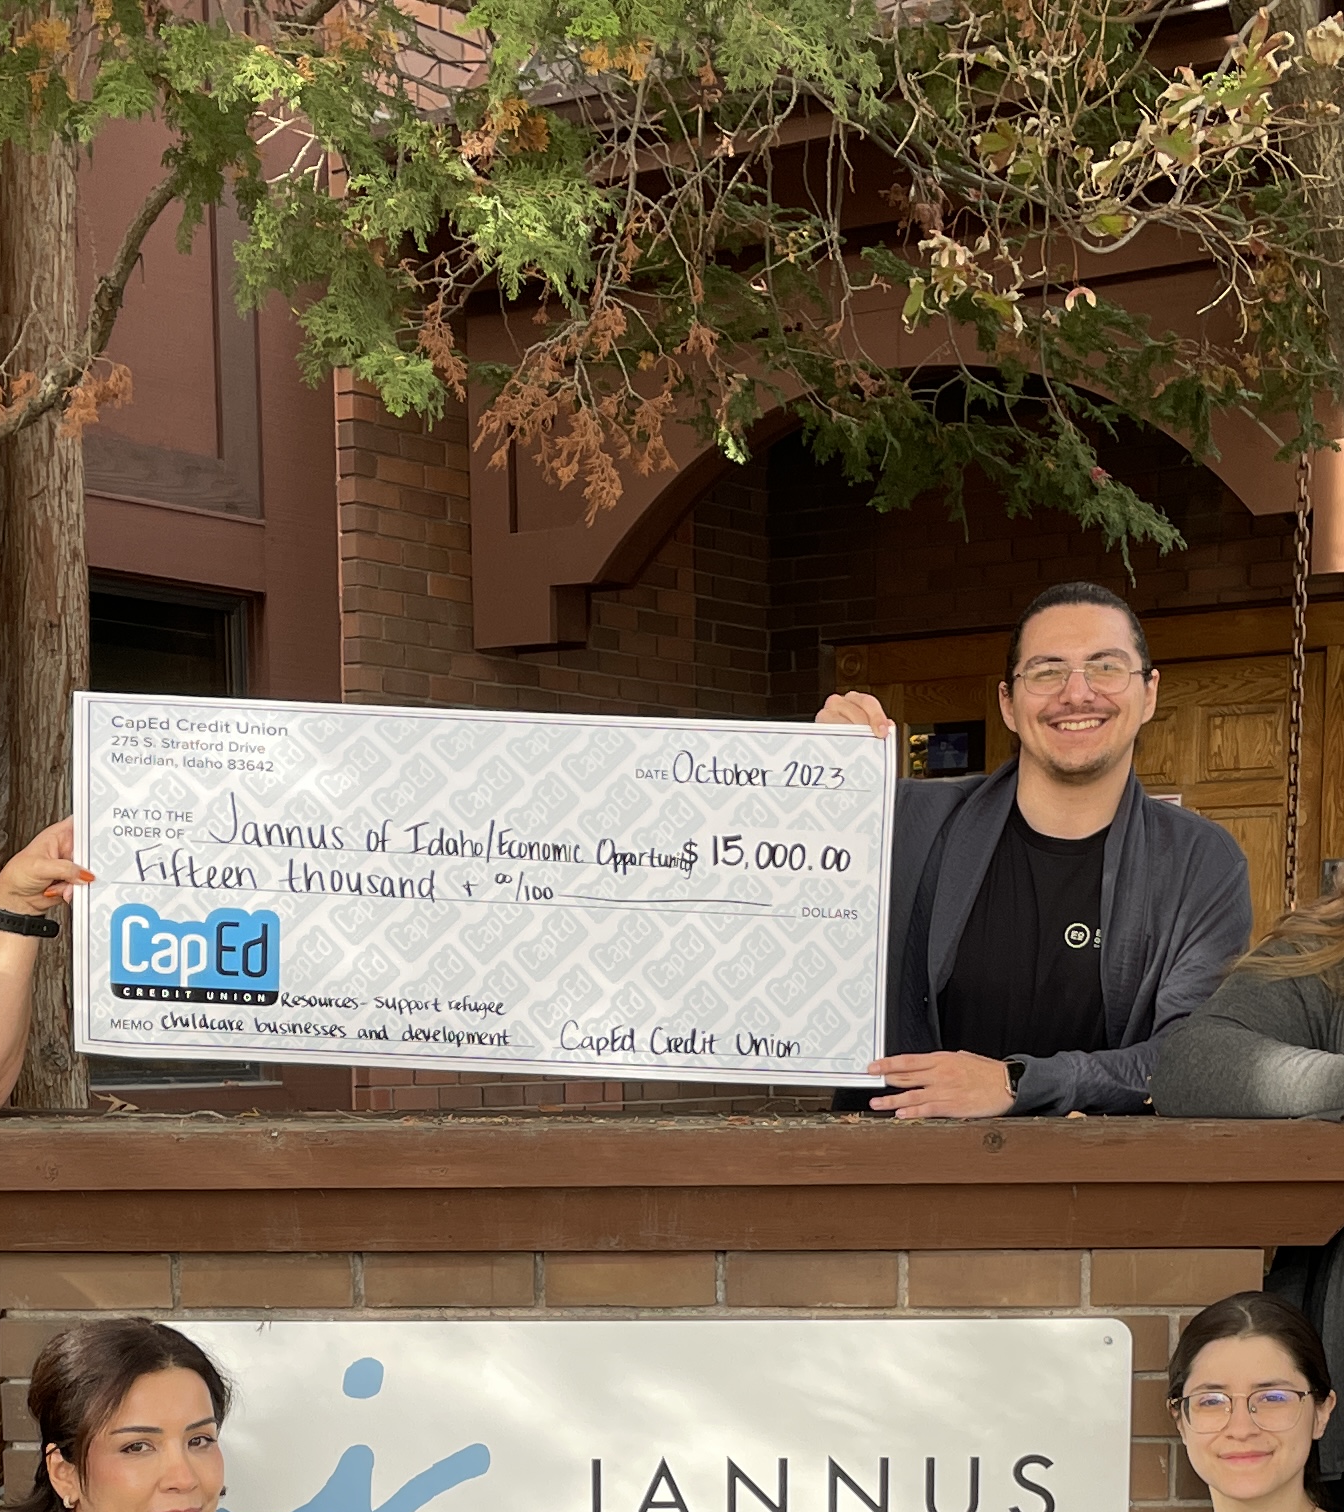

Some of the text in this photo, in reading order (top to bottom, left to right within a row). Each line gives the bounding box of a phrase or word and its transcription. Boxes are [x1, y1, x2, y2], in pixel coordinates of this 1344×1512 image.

[111, 715, 289, 737] CapEd Credit Union
[111, 736, 266, 754] 275 S. Stratford Drive
[111, 752, 275, 773] Meridian, Idaho 83642
[635, 750, 846, 789] DATE October 2023
[113, 807, 194, 823] PAY TO THE
[209, 791, 345, 849] Jannus
[367, 819, 394, 853] of
[112, 825, 185, 840] ORDER OF
[135, 843, 258, 891] Fifteen
[278, 857, 436, 903] thousand
[801, 906, 858, 920] DOLLARS
[121, 914, 269, 989] CapEd
[122, 987, 267, 1003] CREDIT UNION
[447, 994, 507, 1020] refugee
[110, 1018, 154, 1031] MEMO
[254, 1016, 347, 1039] businesses
[357, 1025, 389, 1041] and
[401, 1024, 513, 1048] development
[559, 1019, 801, 1058] CapEd Credit Union
